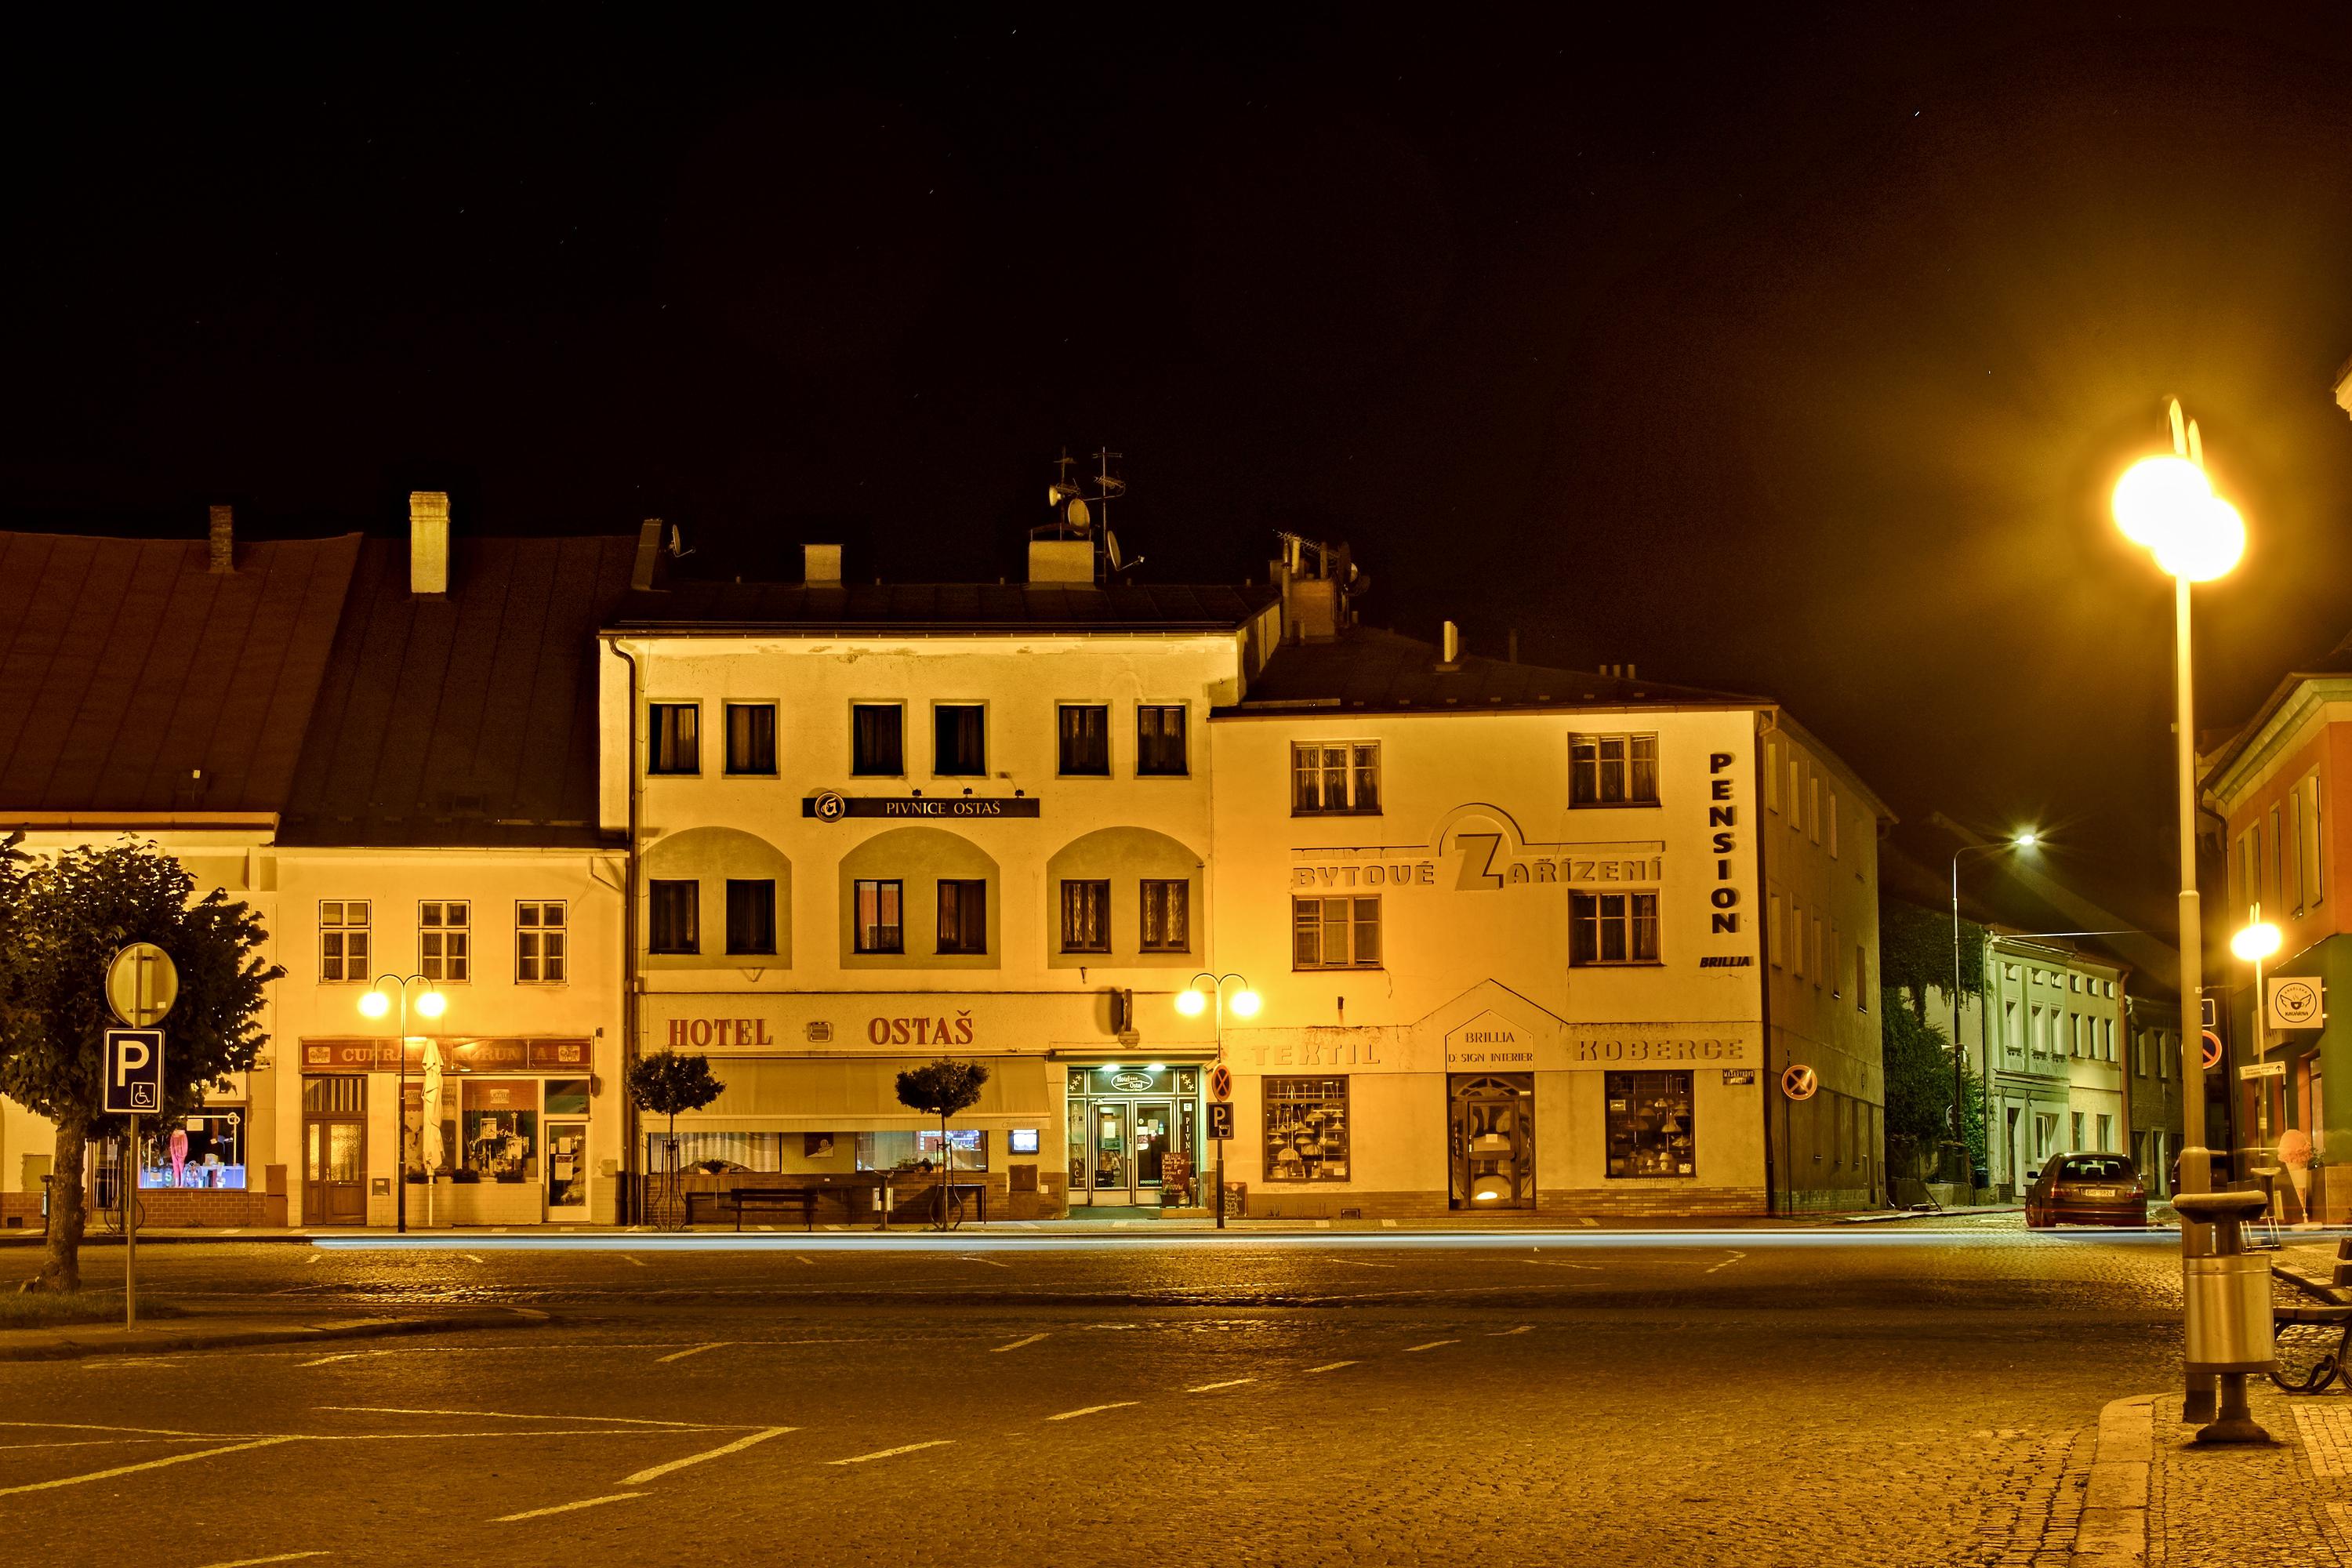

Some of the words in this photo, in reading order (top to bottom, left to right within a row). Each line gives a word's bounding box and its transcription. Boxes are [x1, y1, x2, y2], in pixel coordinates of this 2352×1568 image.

[886, 802, 946, 815] PIVNICE
[953, 800, 1000, 815] OSTAŠ
[1709, 753, 1738, 934] PENSION
[1291, 861, 1434, 887] BYTOVÉ
[1700, 956, 1753, 968] BRILLIA
[668, 1018, 773, 1046] HOTEL
[867, 1009, 974, 1045] OSTAŠ
[1465, 1032, 1515, 1043] BRILLIA
[1251, 1044, 1380, 1065] TEXTIL
[1449, 1053, 1485, 1062] DSIGN
[1573, 1039, 1744, 1061] KOBERCE
[118, 1040, 150, 1087] P
[1214, 1106, 1226, 1127] P
